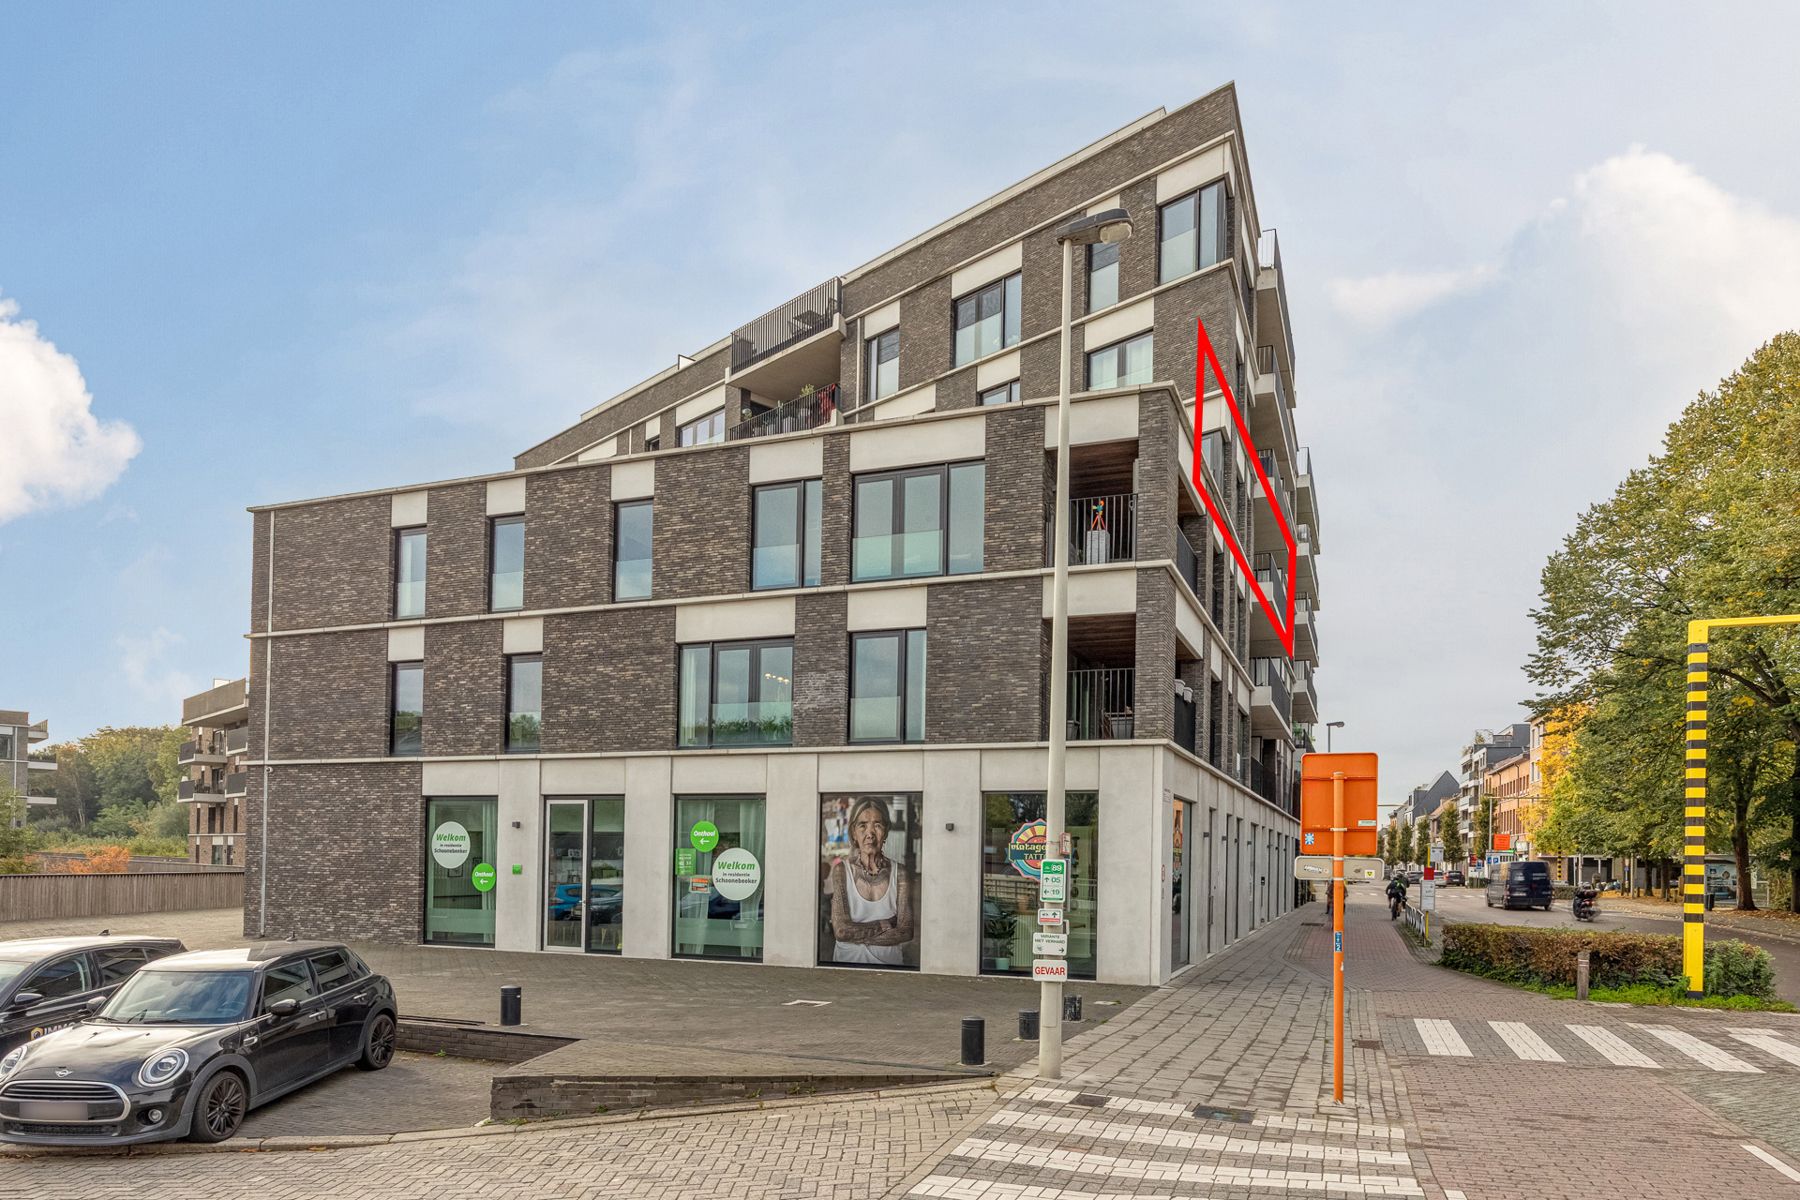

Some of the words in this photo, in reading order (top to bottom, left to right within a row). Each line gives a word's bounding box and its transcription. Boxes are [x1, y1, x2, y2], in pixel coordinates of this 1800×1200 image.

[436, 833, 466, 841] Welkom
[717, 861, 756, 870] Welkom
[1051, 876, 1061, 884] 05
[1034, 966, 1066, 976] GEVAAR
